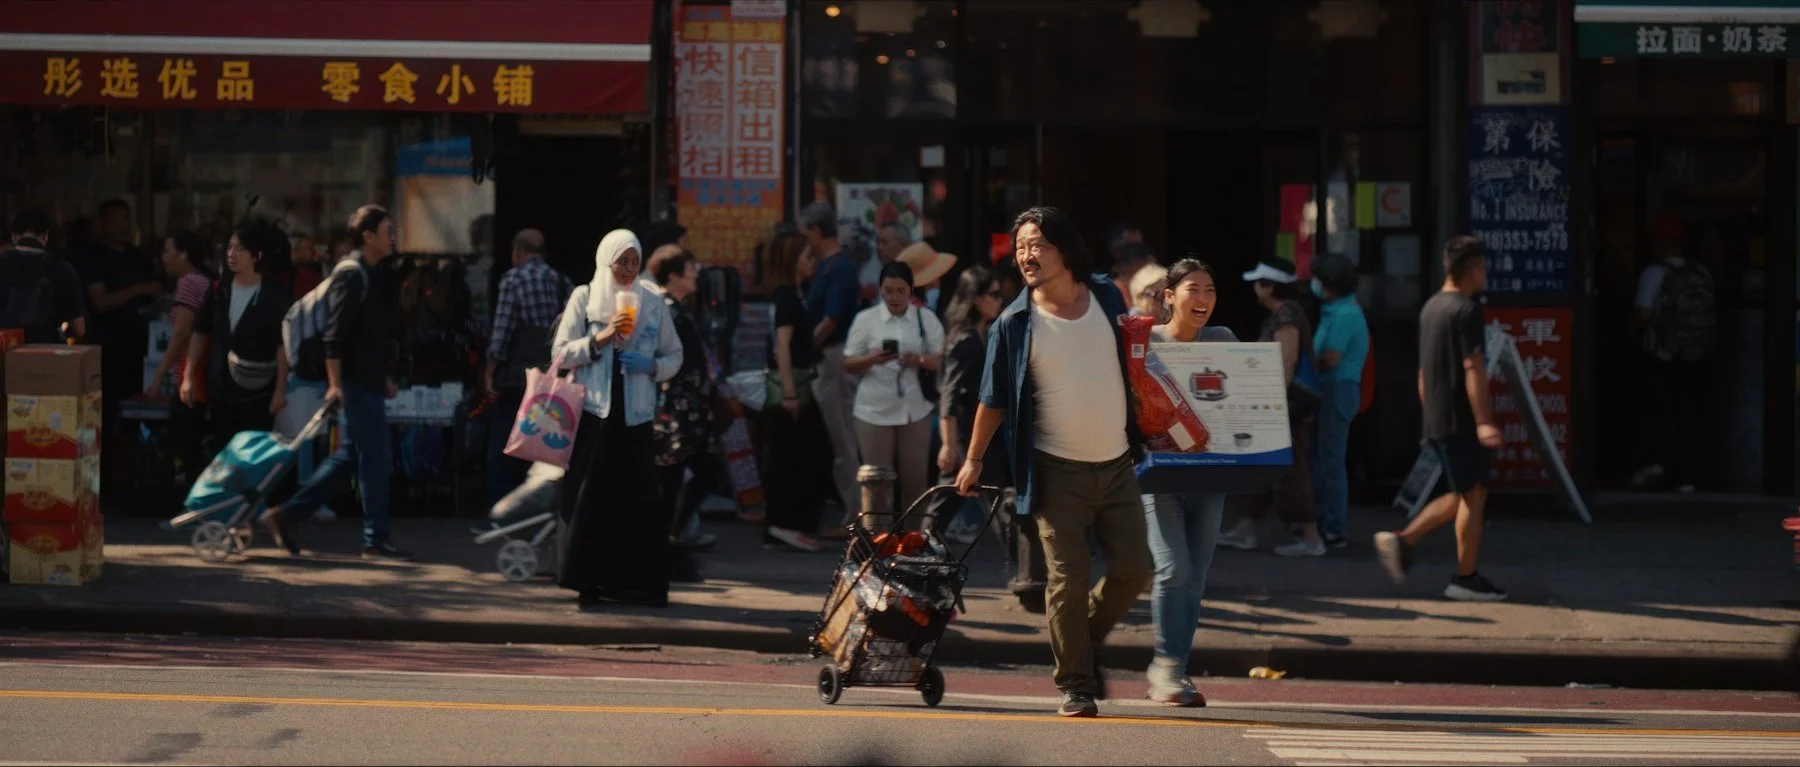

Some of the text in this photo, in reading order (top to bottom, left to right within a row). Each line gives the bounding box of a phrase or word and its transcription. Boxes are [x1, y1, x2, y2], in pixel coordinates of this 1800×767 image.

[1635, 25, 1788, 54] 拉面·奶茶
[43, 57, 536, 106] 彤选优品 零食小铺
[737, 45, 778, 176] 信箱出租
[1524, 119, 1562, 192] 保險
[1504, 198, 1568, 222] INSURANCE
